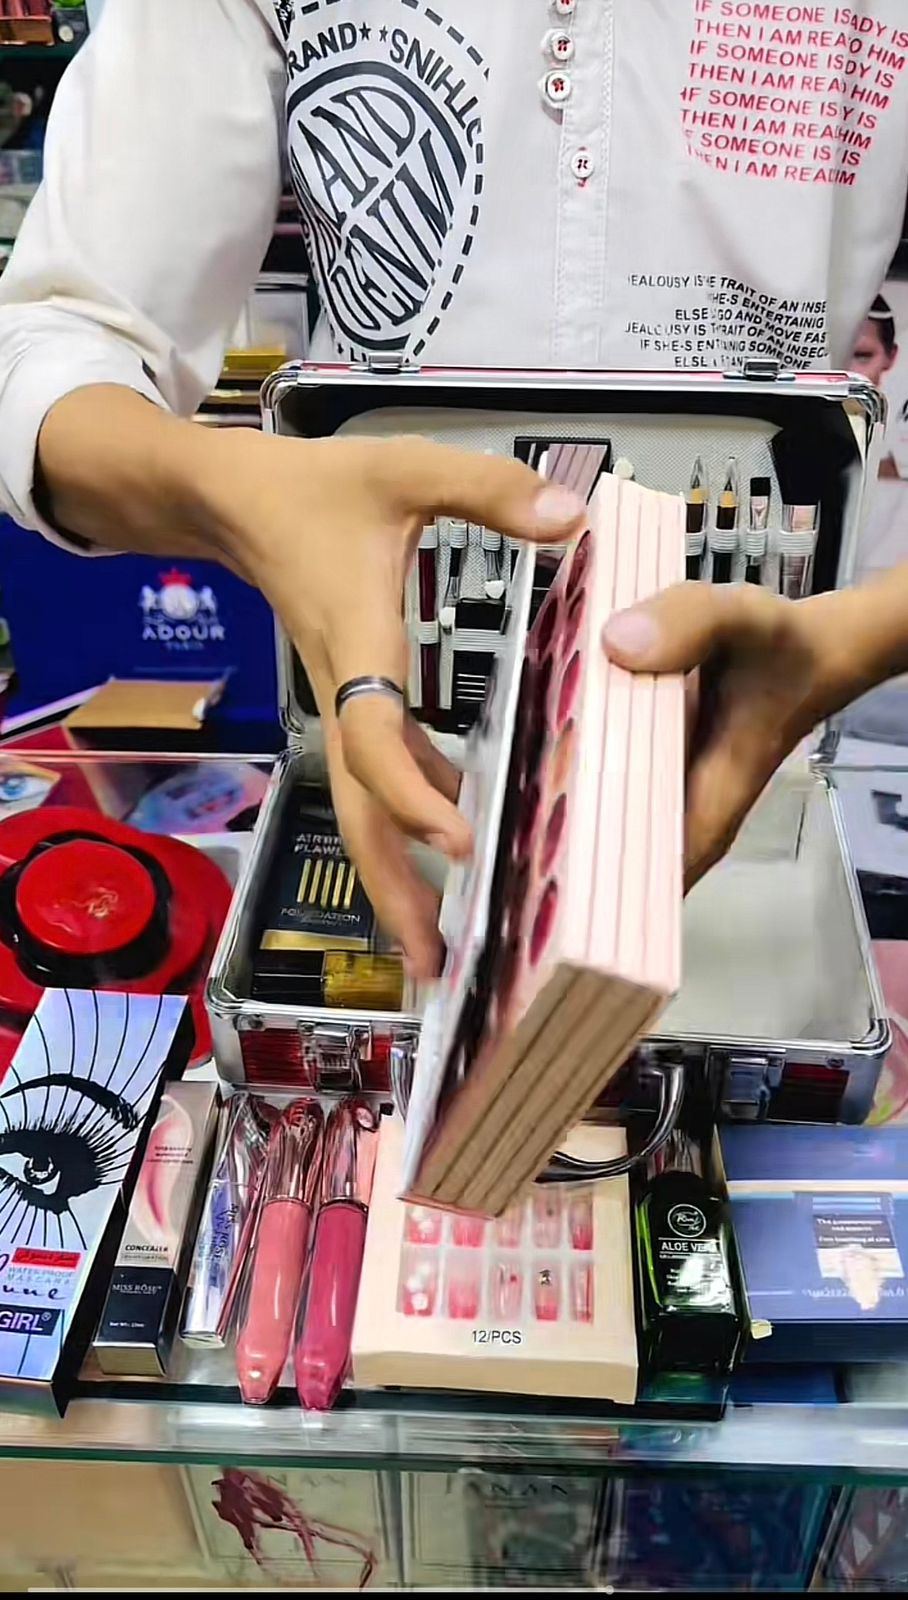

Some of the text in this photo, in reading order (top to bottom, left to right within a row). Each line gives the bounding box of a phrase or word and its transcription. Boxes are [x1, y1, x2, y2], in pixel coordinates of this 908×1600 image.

[695, 0, 712, 12] IF
[720, 2, 825, 23] SOMEONE
[834, 8, 851, 24] IS
[694, 18, 751, 39] THEN
[759, 26, 764, 41] I
[769, 28, 802, 45] AM
[867, 44, 905, 70] HIM
[690, 39, 708, 54] IF
[716, 43, 818, 68] SOMEONE
[827, 54, 844, 70] IS
[874, 69, 894, 88] IS
[688, 62, 745, 83] THEN
[751, 69, 756, 85] I
[761, 72, 794, 89] AM
[850, 84, 889, 109] HIM
[680, 108, 735, 130] THEN
[742, 116, 747, 131] I
[752, 118, 786, 135] AM
[708, 89, 812, 115] SOMEONE
[820, 101, 837, 117] IS
[857, 111, 877, 129] IS
[701, 133, 805, 158] SOMEONE
[813, 145, 831, 160] IS
[841, 149, 860, 166] IS
[735, 159, 739, 173] I
[745, 161, 777, 178] AM
[721, 277, 756, 297] TRAIT
[759, 294, 777, 307] OF
[778, 300, 799, 312] AN
[675, 307, 708, 321] ELSE
[735, 310, 762, 325] AND
[765, 321, 802, 343] MOVE
[694, 324, 706, 336] IS
[747, 326, 765, 338] OF
[766, 335, 784, 349] AN
[640, 339, 650, 350] IF
[748, 341, 812, 370] SOMEONE
[661, 1242, 689, 1252] ALOE
[472, 1331, 522, 1344] 12/PCS
